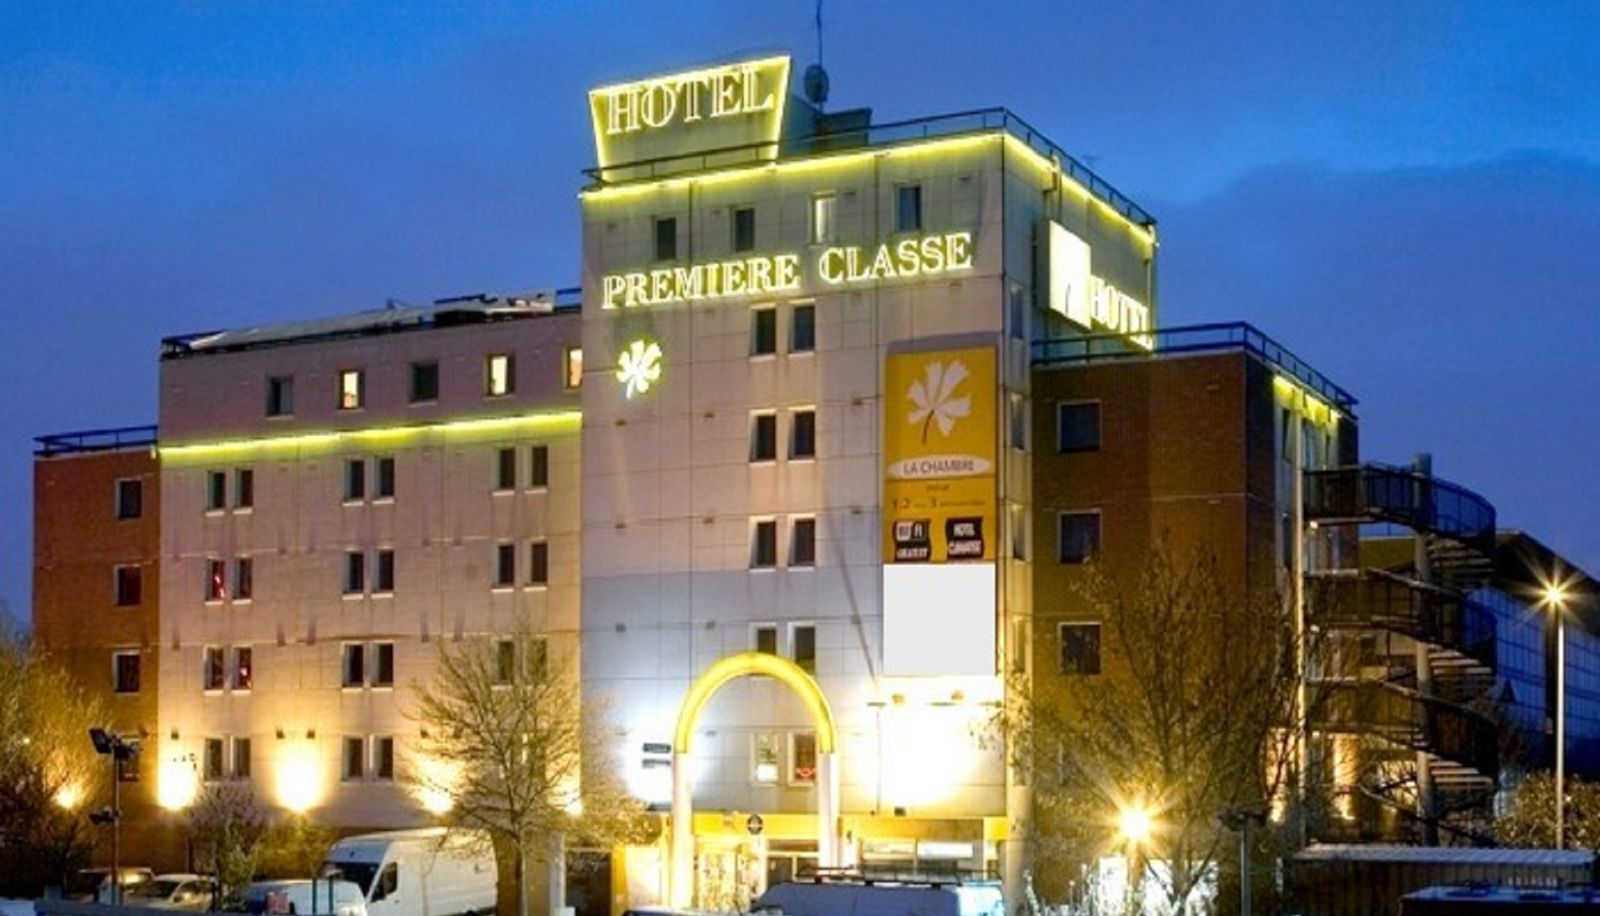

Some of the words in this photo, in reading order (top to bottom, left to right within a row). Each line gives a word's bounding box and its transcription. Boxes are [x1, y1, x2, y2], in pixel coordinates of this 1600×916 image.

[606, 67, 775, 135] HOTEL
[601, 254, 800, 310] PREMIERE
[818, 231, 973, 285] CLASSE
[1089, 274, 1154, 351] HOTEL
[903, 461, 918, 475] LA
[920, 459, 974, 474] CHAMBRE
